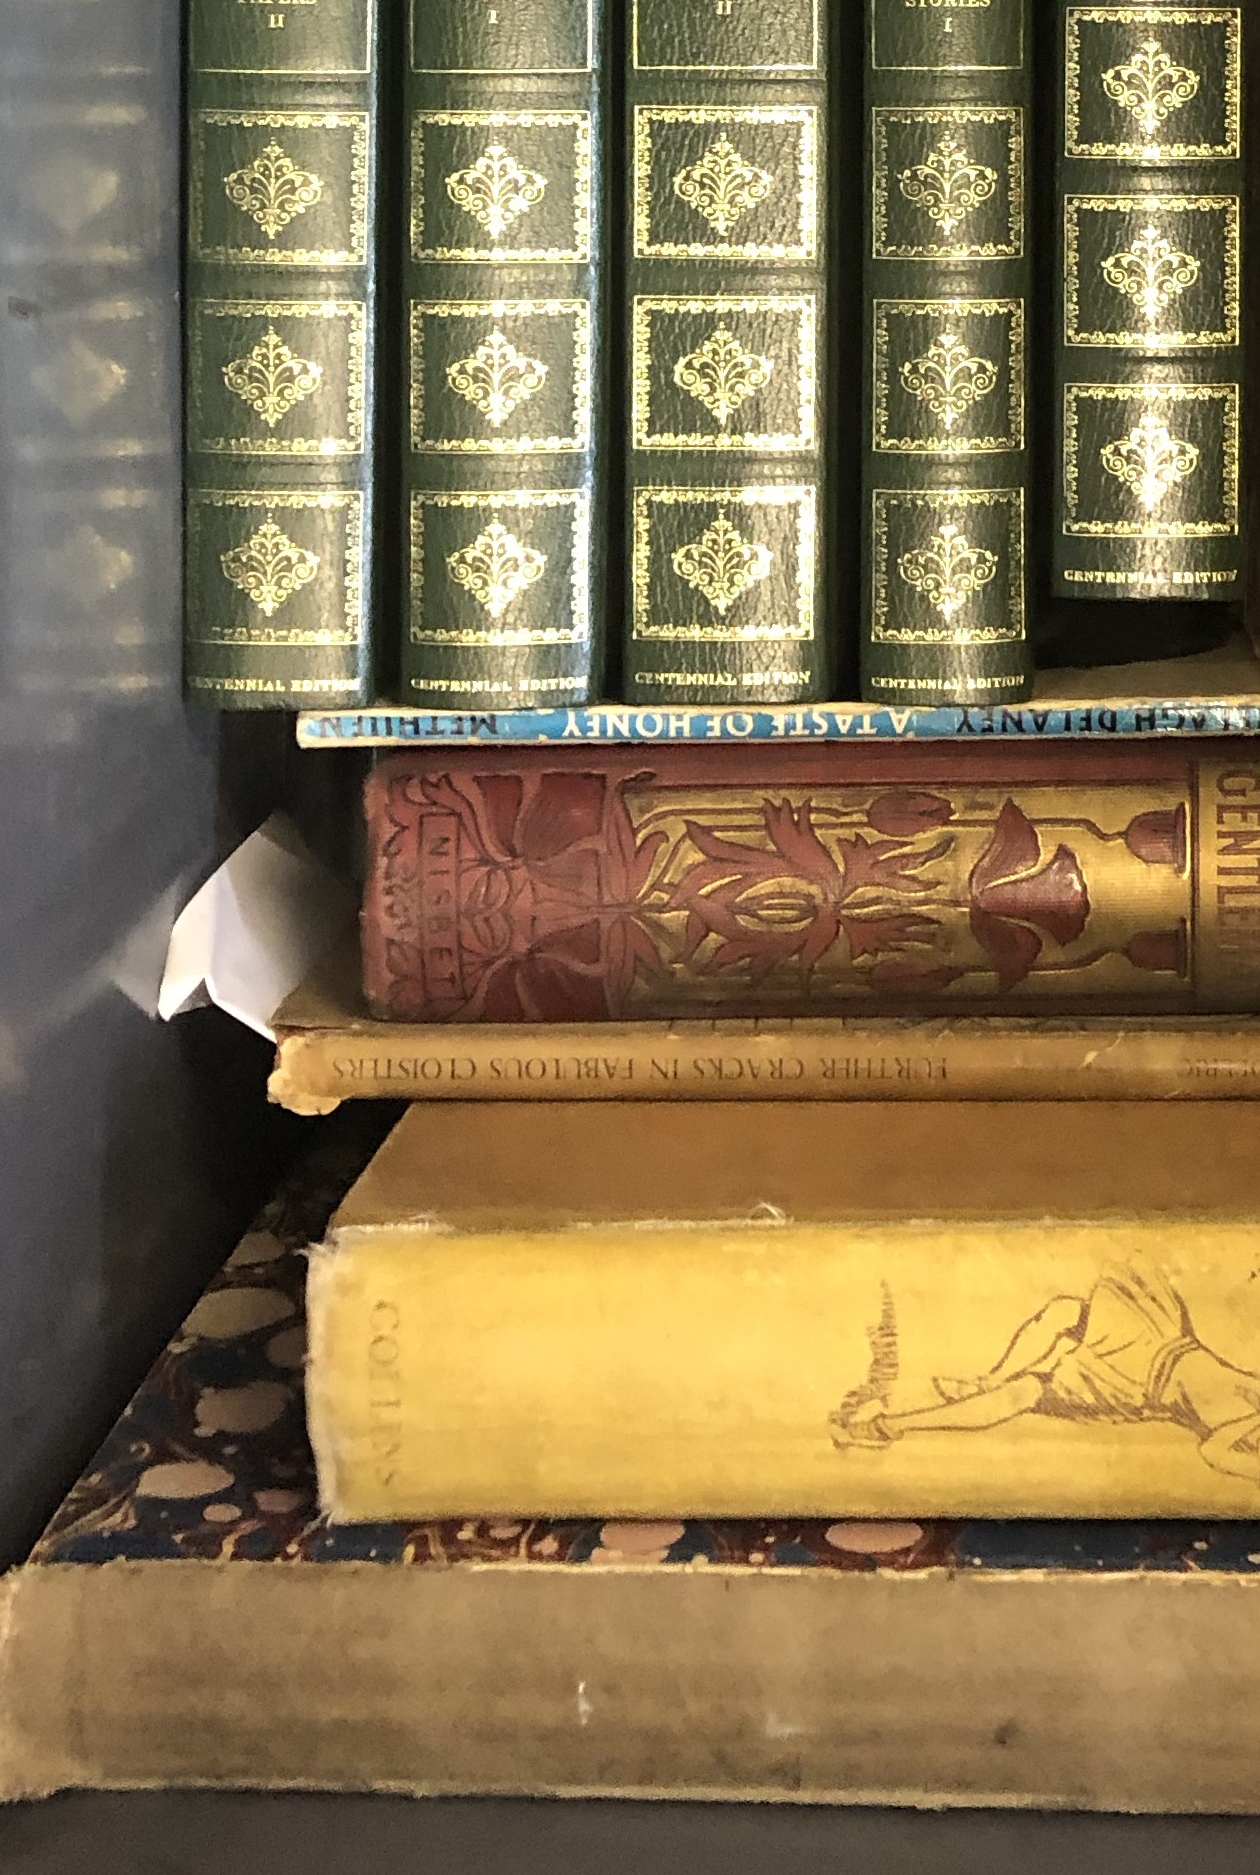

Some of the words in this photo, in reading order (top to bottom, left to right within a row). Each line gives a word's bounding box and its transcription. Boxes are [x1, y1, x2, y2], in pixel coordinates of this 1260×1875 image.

[488, 8, 499, 25] I
[716, 0, 731, 16] II
[268, 14, 284, 29] II
[943, 17, 953, 33] I
[1063, 569, 1164, 585] CENTENNIAL
[1172, 569, 1238, 585] EDITION
[290, 677, 362, 693] EDITION
[518, 675, 589, 692] EDITION
[742, 670, 811, 686] EDITION
[967, 674, 1025, 690] EDITION
[562, 711, 692, 738] HONEY
[708, 712, 754, 739] OF
[770, 709, 877, 737] TASTE
[887, 708, 915, 736] A
[956, 708, 1120, 735] DELANEY
[427, 836, 457, 988] NISBET
[333, 1056, 478, 1081] CLOISTERS
[490, 1056, 635, 1081] FABULOUS
[651, 1057, 680, 1081] IN
[694, 1057, 805, 1081] CRACKS
[821, 1056, 949, 1081] FURTHER
